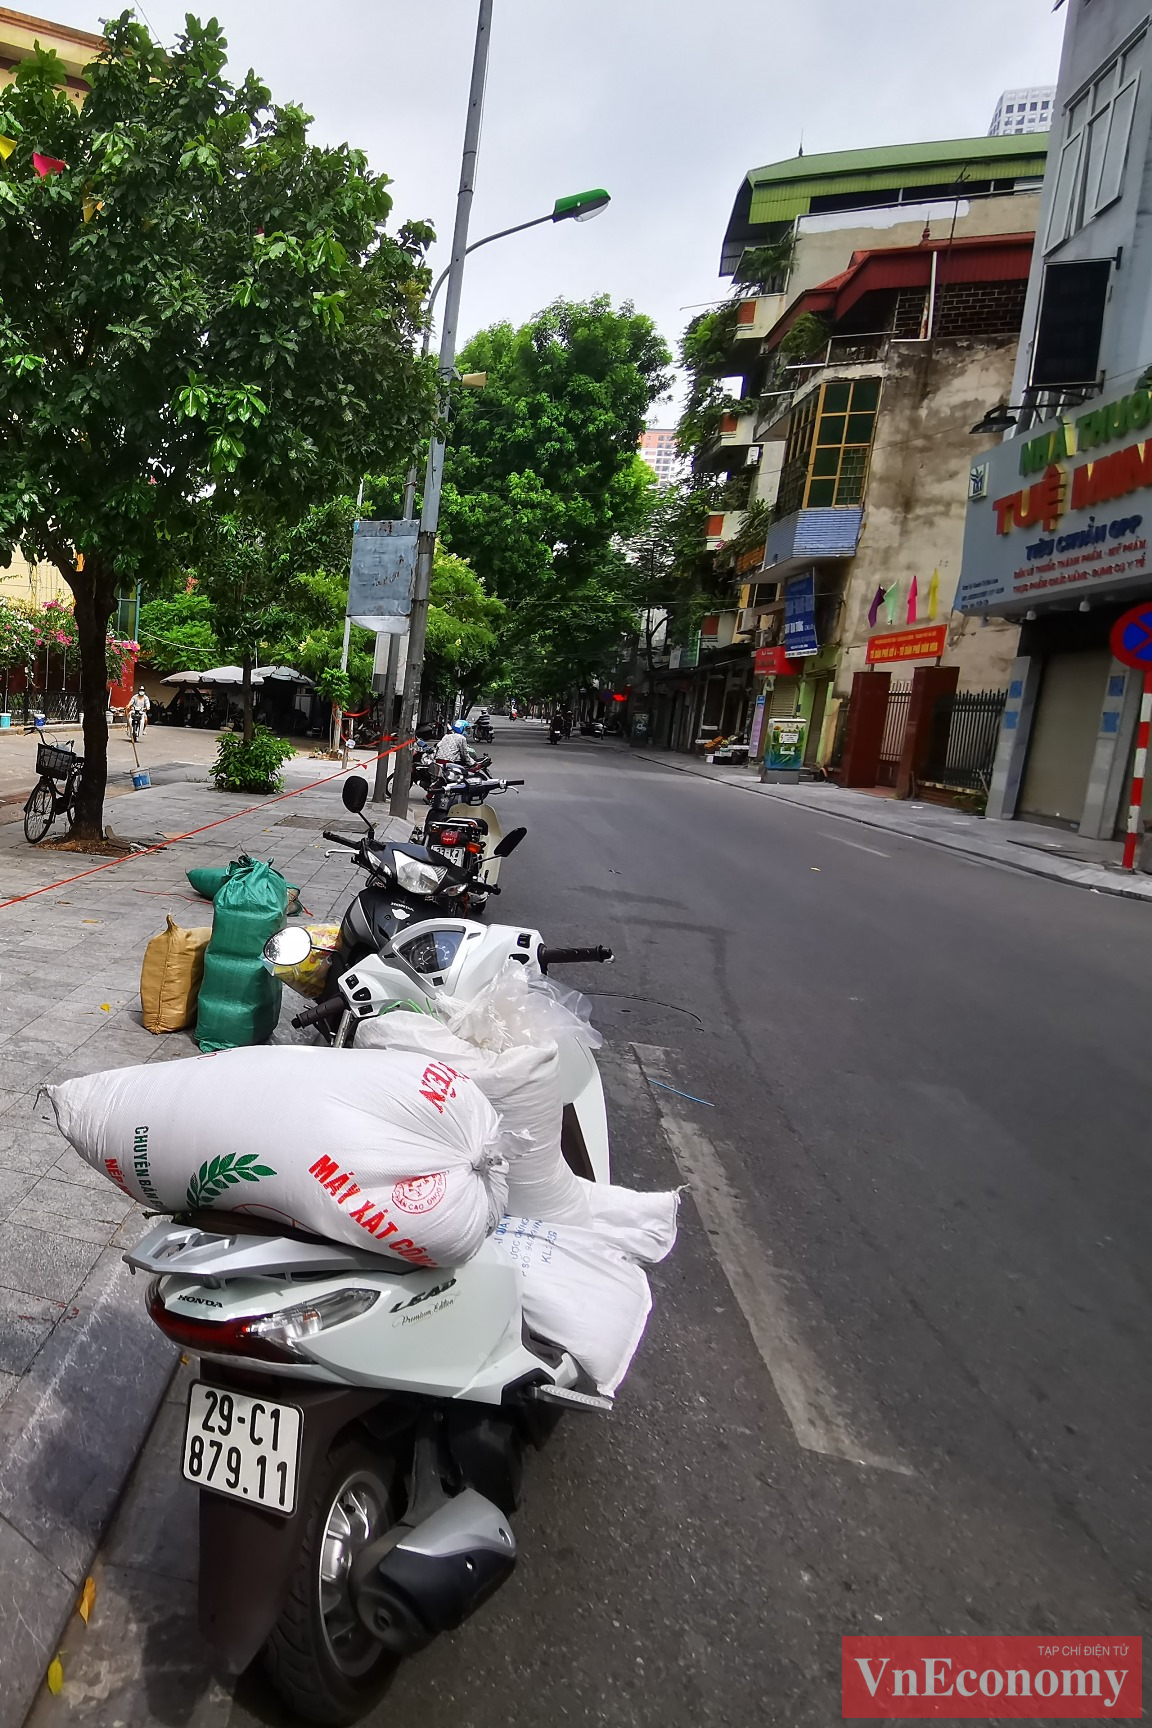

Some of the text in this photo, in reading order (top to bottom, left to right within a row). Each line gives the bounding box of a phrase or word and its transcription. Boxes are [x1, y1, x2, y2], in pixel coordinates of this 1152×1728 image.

[1020, 415, 1076, 476] NHÀ
[992, 463, 1066, 536] TUỆ
[134, 1126, 158, 1207] CHUYÊN BÁN
[308, 1154, 361, 1205] MÁY
[349, 1200, 399, 1240] XÁT
[177, 1294, 223, 1309] HONDA
[390, 1278, 457, 1313] LEAD
[399, 1298, 454, 1326] Premium Edition
[202, 1390, 281, 1452] 29-C1
[188, 1435, 288, 1506] 879.11
